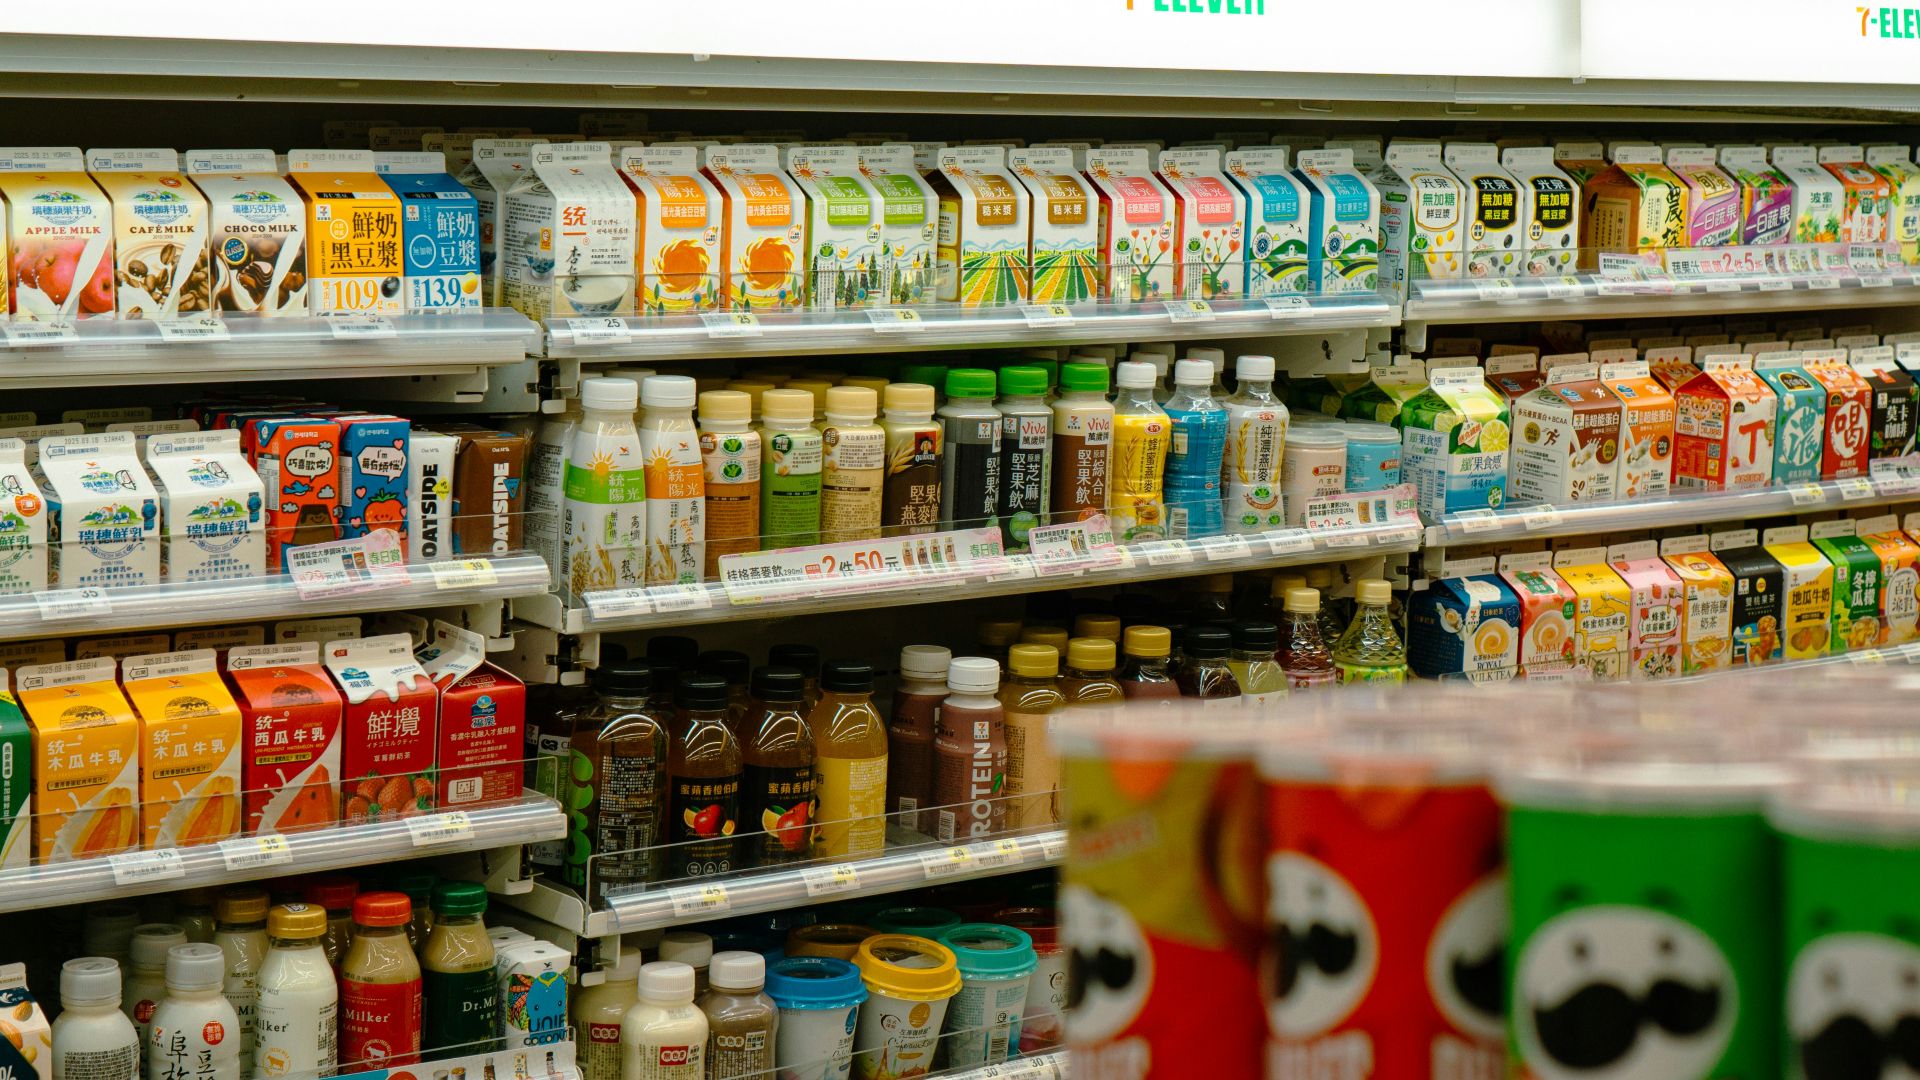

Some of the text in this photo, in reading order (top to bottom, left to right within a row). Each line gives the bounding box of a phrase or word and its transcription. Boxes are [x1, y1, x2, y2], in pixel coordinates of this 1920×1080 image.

[1419, 178, 1450, 189] 光泉
[1480, 179, 1509, 190] 光泉
[1538, 179, 1566, 190] 光泉
[1422, 193, 1456, 206] 無加糖
[1481, 193, 1513, 207] 無加糖
[1539, 193, 1570, 207] 無加糖
[1426, 209, 1451, 219] 鮮豆漿
[1484, 209, 1510, 221] 黑豆漿
[1542, 209, 1567, 220] 黑豆漿
[1693, 204, 1738, 231] 一日蔬果
[1745, 204, 1791, 233] 一日蔬果
[25, 226, 101, 235] APPLE MILK
[129, 224, 195, 234] CAFÉ MILK
[224, 224, 298, 233] CHOCO MILK
[352, 211, 398, 240] 鮮奶
[436, 211, 476, 239] 鮮奶
[330, 241, 398, 269] 黑豆漿
[438, 239, 477, 267] 豆漿
[604, 317, 621, 328] 25
[736, 314, 751, 325] 25
[1022, 421, 1046, 434] Viva
[1087, 417, 1110, 431] Viva
[1834, 403, 1865, 454] 喝
[1022, 436, 1046, 446] 萬歲牌
[1087, 431, 1110, 441] 萬歲牌
[608, 474, 641, 487] 統一
[667, 469, 699, 483] 統一
[1009, 453, 1026, 509] 堅果飲
[1024, 463, 1041, 501] 芝麻
[1076, 449, 1092, 505] 堅果飲
[1091, 459, 1105, 496] 綜合
[668, 483, 700, 497] 陽光
[983, 457, 997, 514] 堅果飲
[608, 488, 641, 502] 陽光
[910, 484, 936, 504] 堅果
[492, 463, 510, 557] OATSIDE
[78, 527, 145, 544] 瑞穗鮮乳
[186, 519, 251, 538] 瑞穗鮮乳
[727, 565, 784, 582] 桂格燕麥飲
[1792, 588, 1830, 606] 地瓜牛奶
[1477, 660, 1504, 672] ROYAL
[1470, 670, 1512, 682] MILK TEA
[255, 727, 326, 747] 西瓜牛乳
[153, 739, 226, 760] 木瓜牛乳
[48, 749, 123, 771] 木瓜牛乳
[970, 742, 993, 841] ROTEIN
[1031, 1058, 1045, 1068] 30
[983, 1067, 998, 1078] 30
